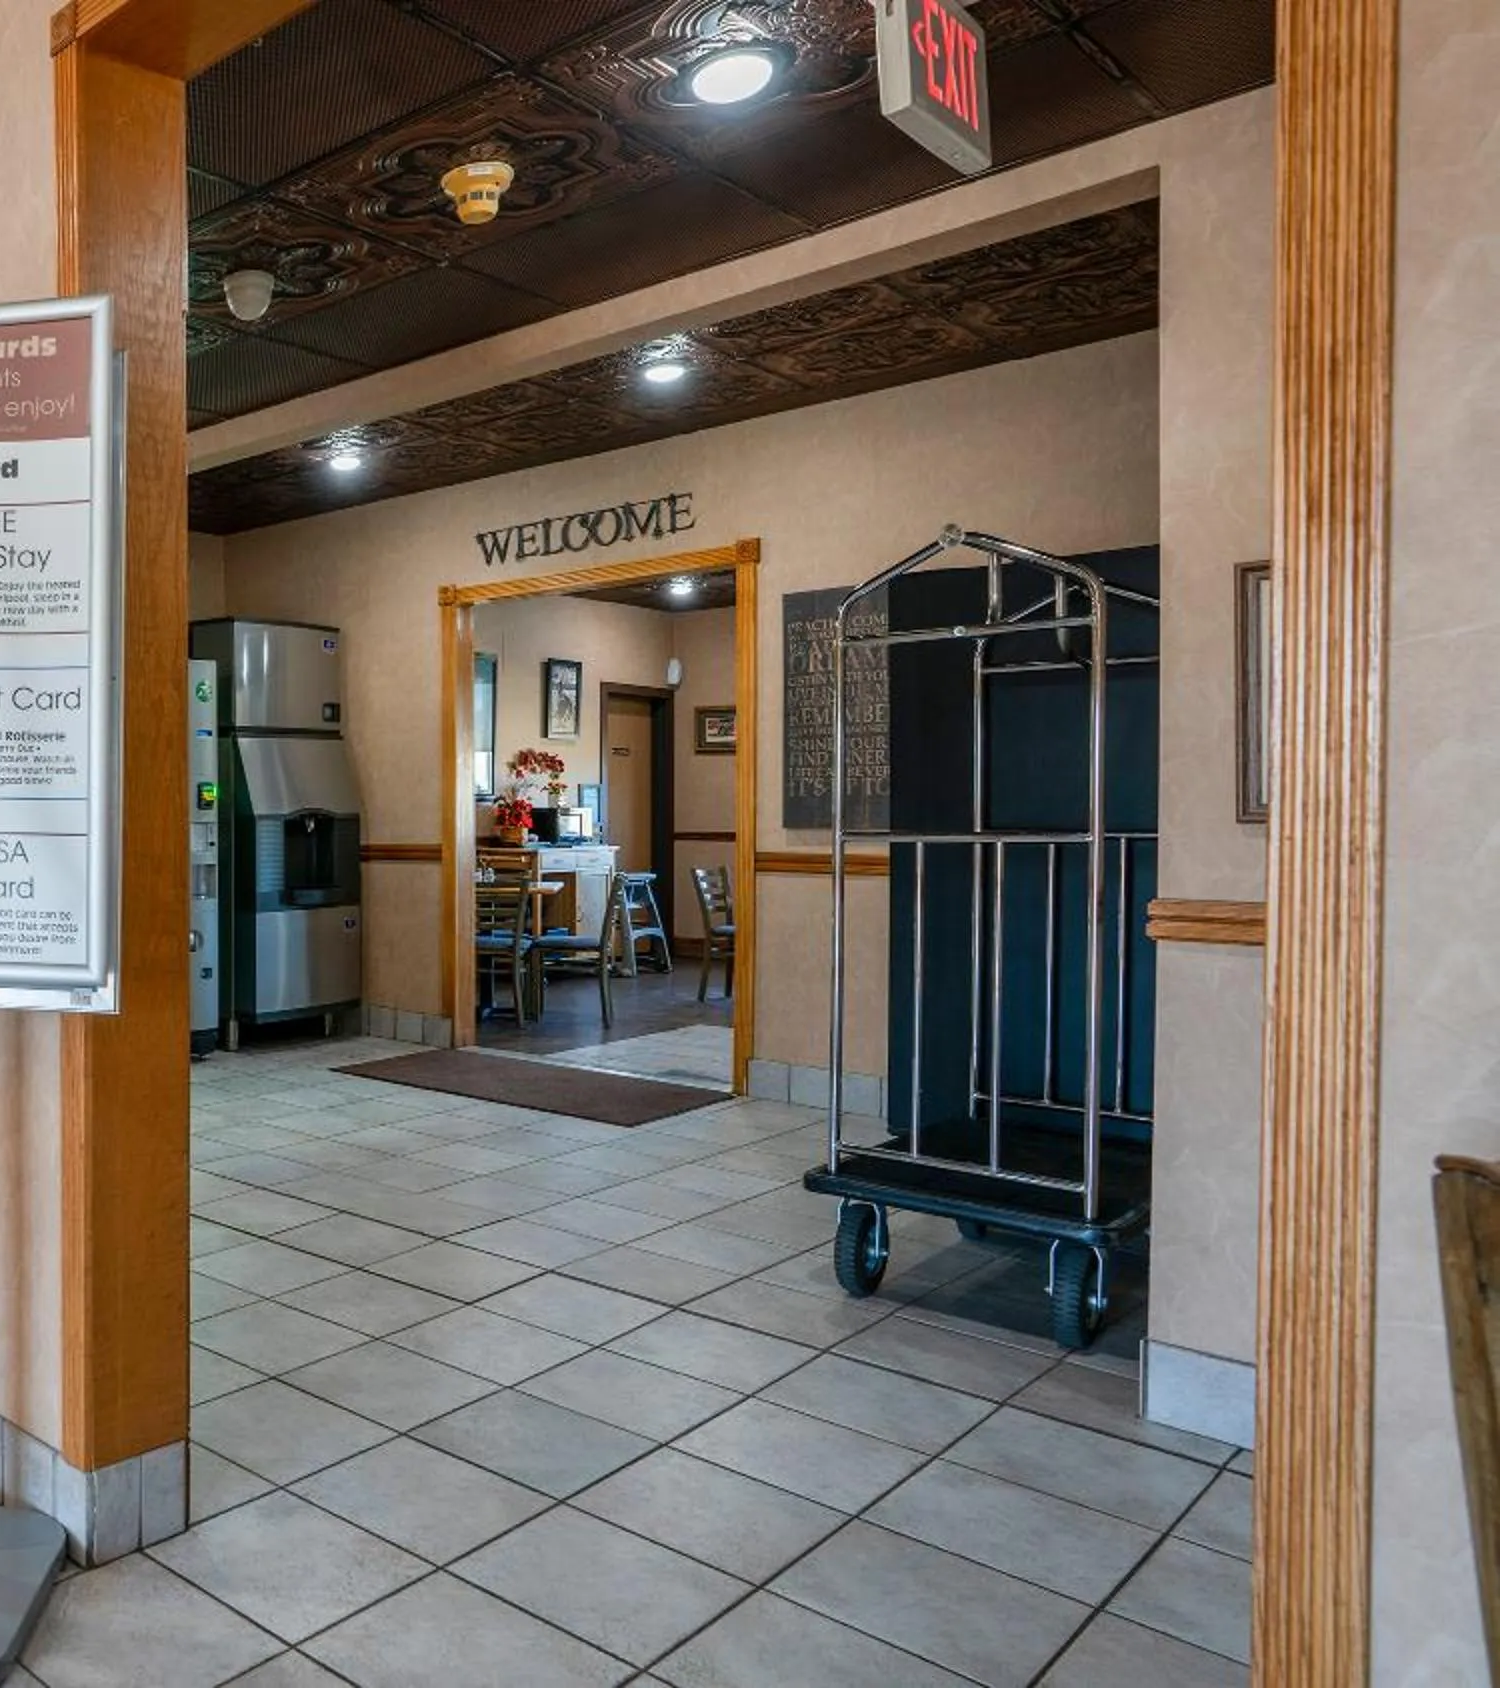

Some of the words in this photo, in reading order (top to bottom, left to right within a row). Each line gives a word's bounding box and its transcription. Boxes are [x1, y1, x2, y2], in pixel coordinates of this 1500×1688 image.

[923, 0, 979, 132] EXIT
[3, 391, 76, 421] enjoy!
[474, 491, 697, 567] WELCOME
[11, 685, 82, 712] Card
